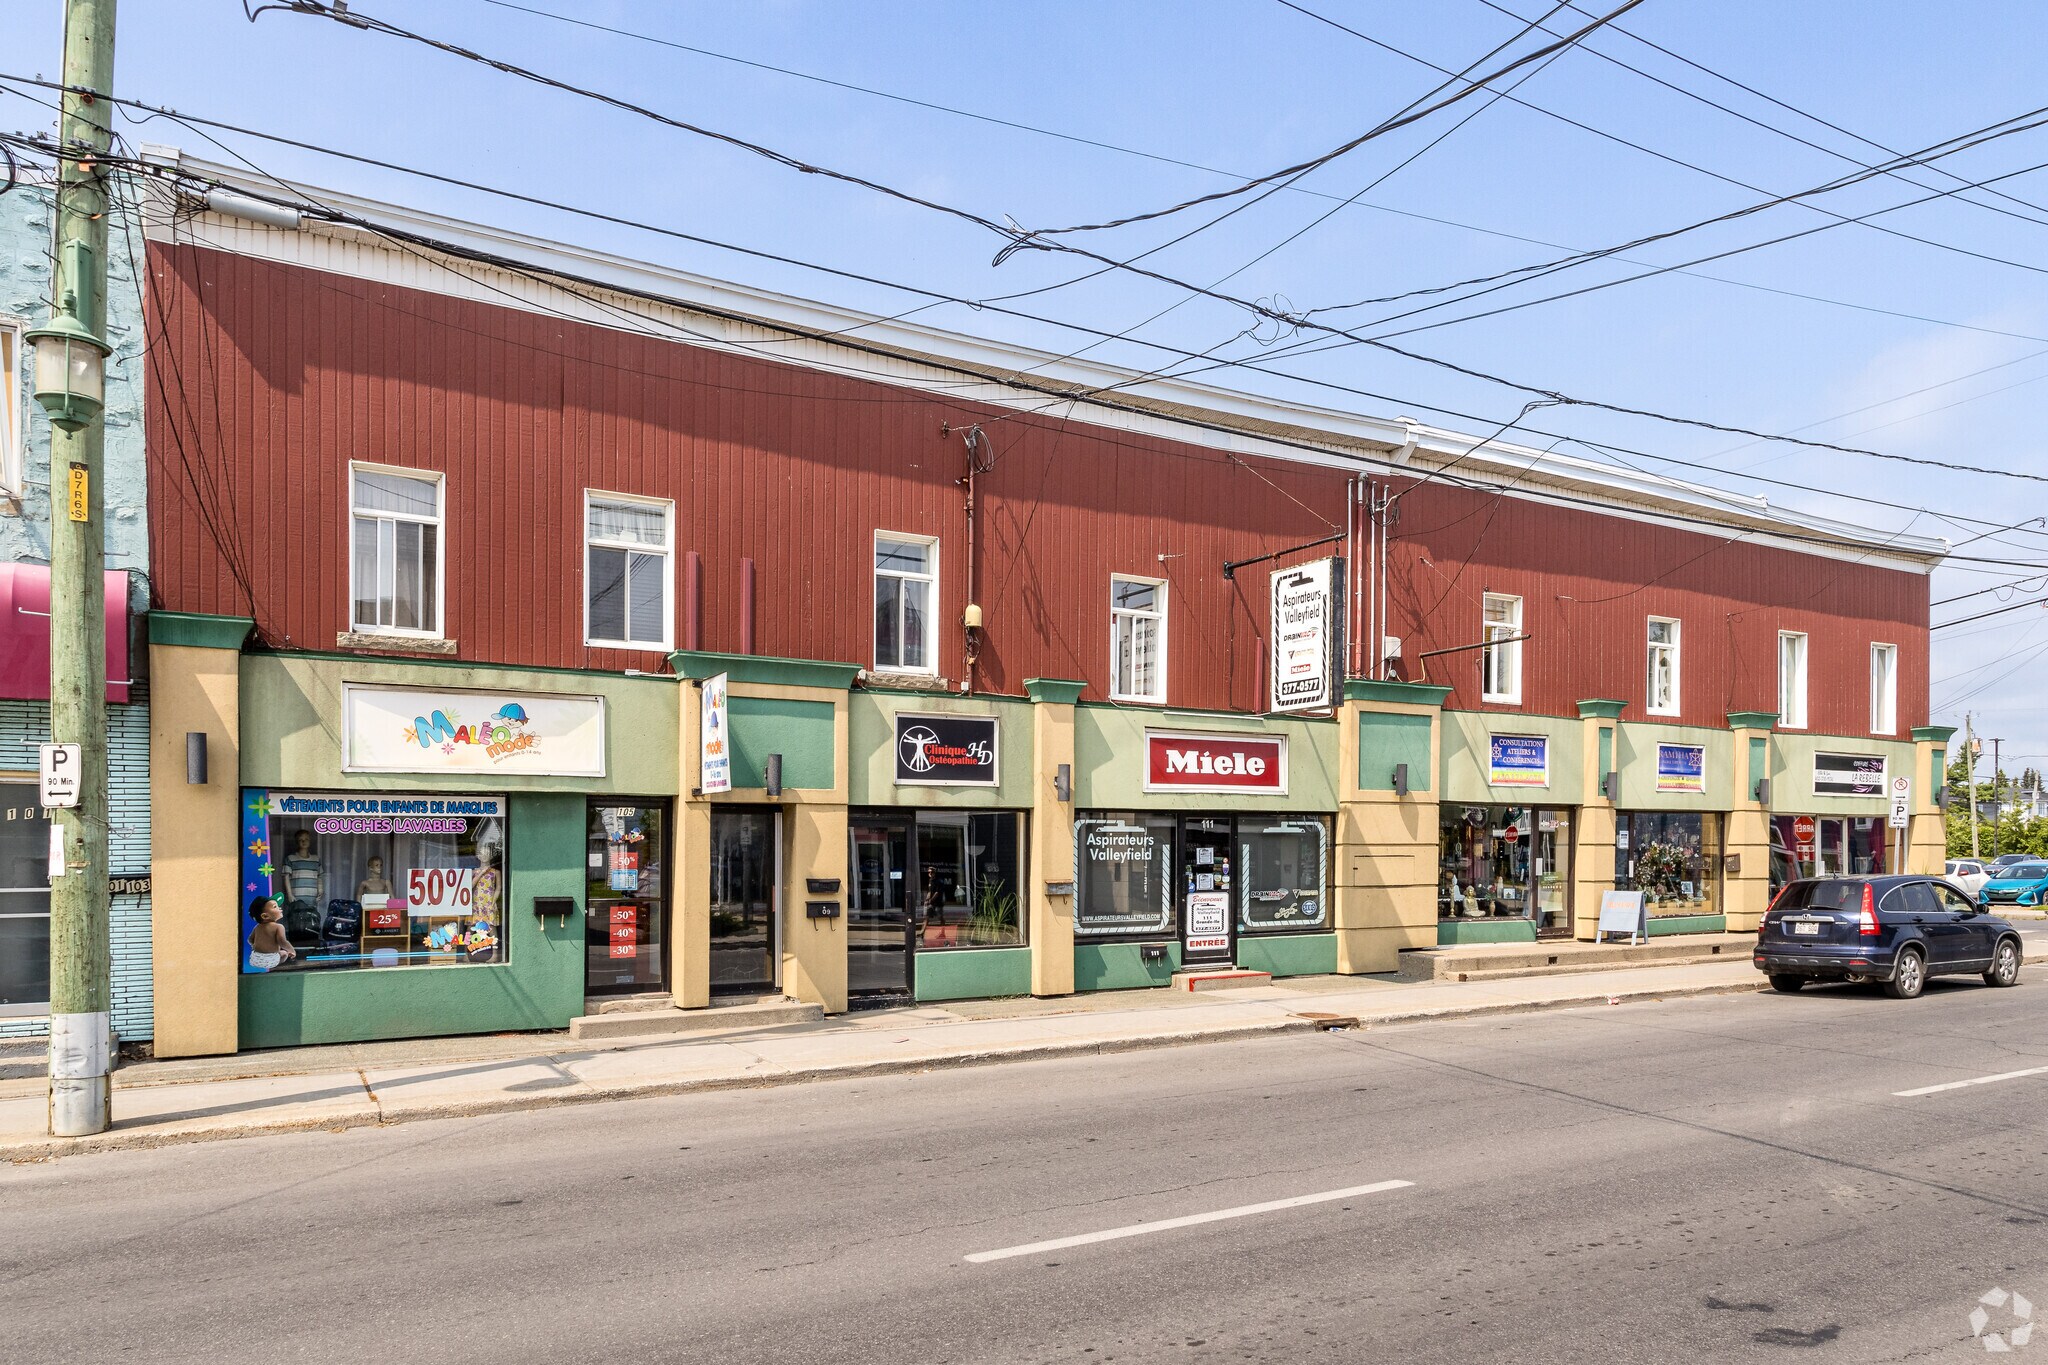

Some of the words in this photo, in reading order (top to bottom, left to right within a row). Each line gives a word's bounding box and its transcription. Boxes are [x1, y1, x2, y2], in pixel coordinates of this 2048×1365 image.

[1283, 590, 1321, 609] Aspirateurs
[1285, 603, 1320, 624] Valleyfield
[1283, 679, 1319, 694] 377-0577
[486, 733, 533, 758] mode
[1499, 738, 1544, 747] CONSULTATIONS
[924, 744, 967, 757] Clinique
[1507, 748, 1531, 756] ATELIERS
[52, 750, 68, 772] P
[929, 755, 978, 766] Ostéopathie
[1166, 749, 1266, 776] Miele
[280, 795, 344, 813] VÊTEMENTS
[346, 799, 380, 813] POUR
[380, 799, 429, 814] ENFANTS
[430, 801, 446, 814] DE
[446, 801, 499, 815] MARQUES
[1896, 806, 1905, 816] P
[618, 808, 635, 816] 105
[315, 818, 392, 834] COUCHES
[393, 818, 467, 834] LAVABLES
[1201, 819, 1214, 829] 111
[1086, 832, 1155, 849] Aspirateurs
[1089, 847, 1153, 864] Valleyfield
[408, 868, 471, 907] 50%
[373, 913, 399, 924] -25%
[612, 909, 635, 920] -50%
[612, 927, 635, 938] -40%
[1189, 937, 1226, 948] ENTRÉE
[612, 944, 635, 955] -30%
